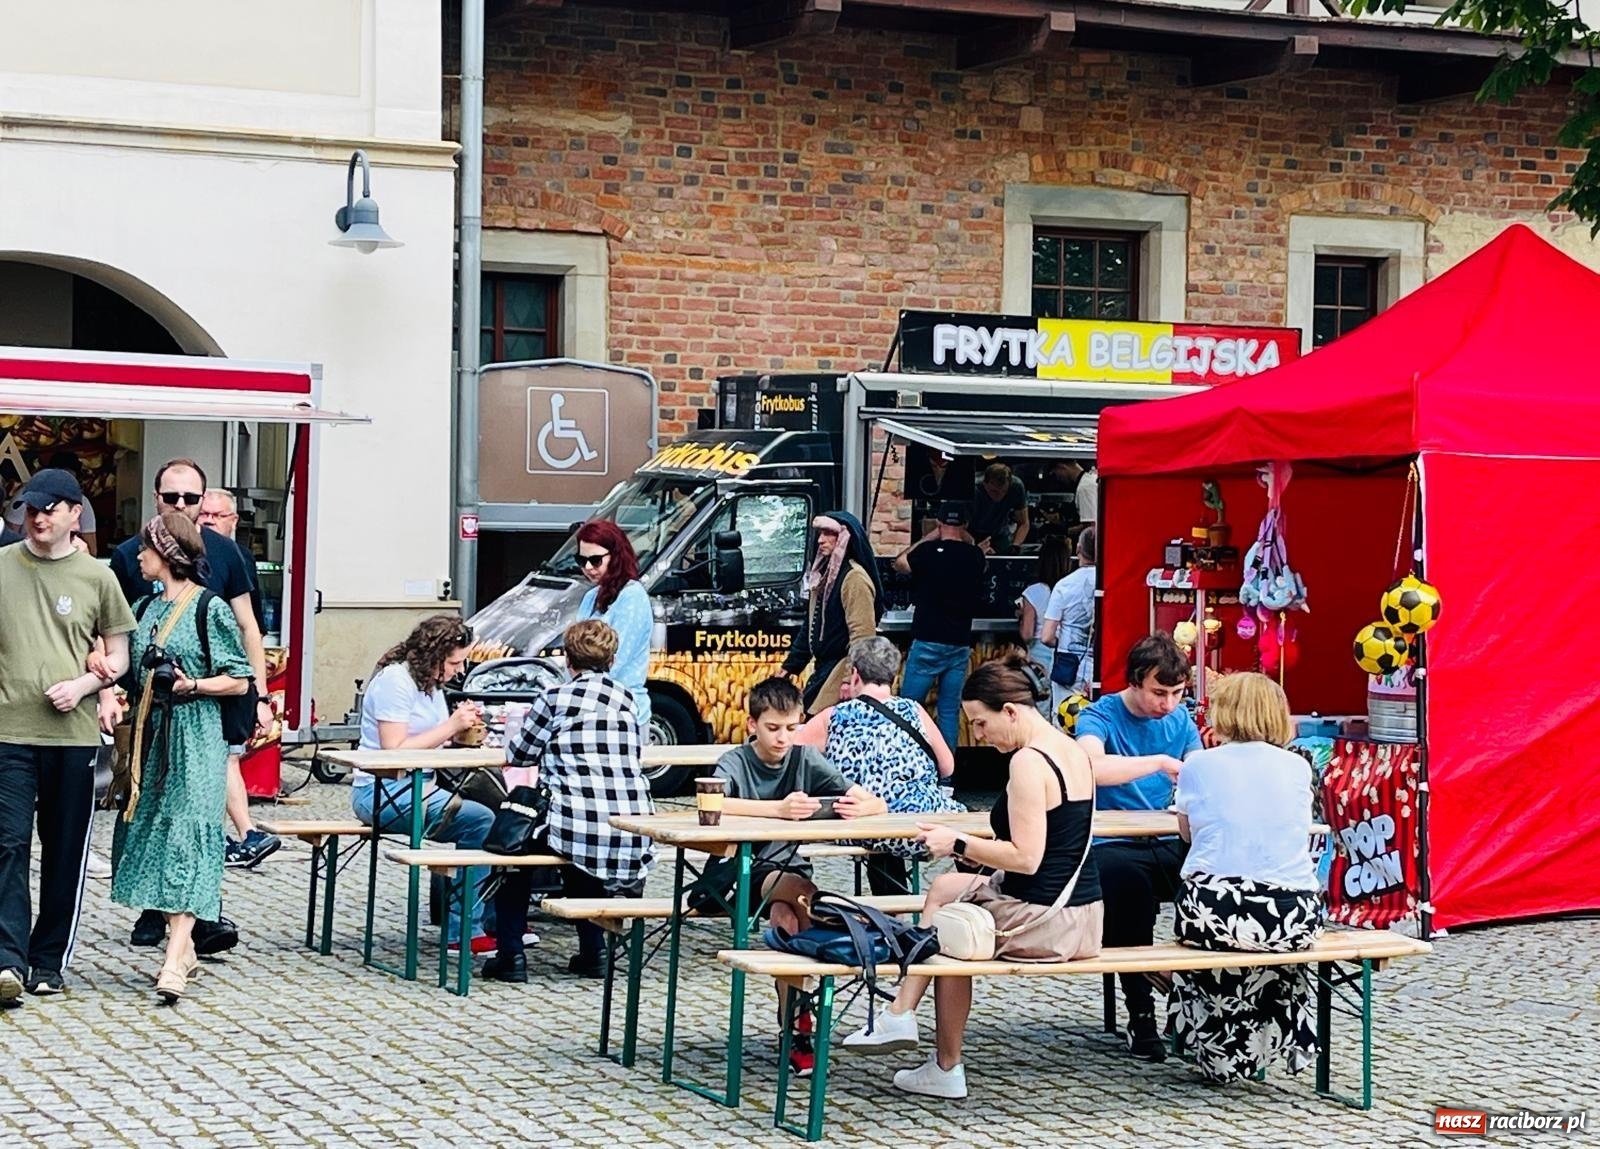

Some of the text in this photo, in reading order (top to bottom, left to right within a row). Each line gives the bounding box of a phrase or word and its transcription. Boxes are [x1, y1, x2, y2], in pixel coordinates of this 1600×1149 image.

[933, 324, 1280, 378] FRYTKA BELGIJSKA
[761, 394, 805, 415] Frytkobus
[695, 630, 792, 651] Frytkobus
[1340, 814, 1395, 865] POP
[1344, 849, 1404, 898] CORN
